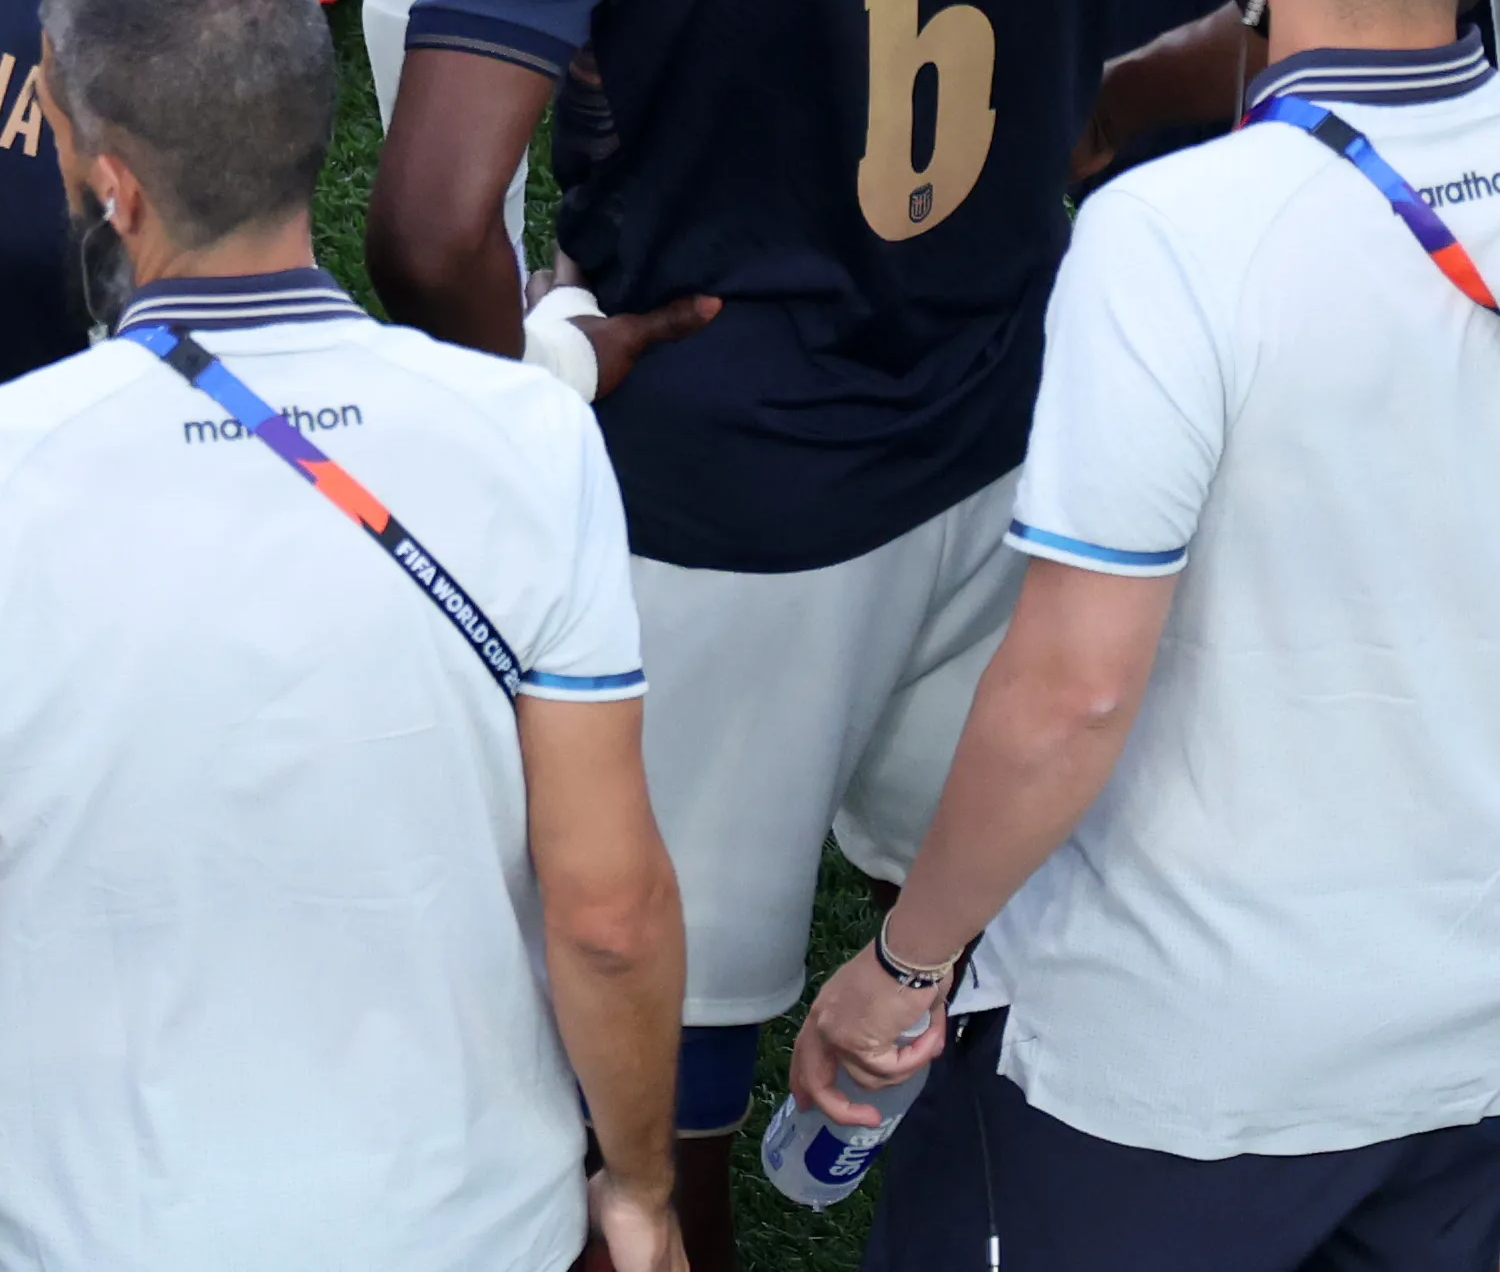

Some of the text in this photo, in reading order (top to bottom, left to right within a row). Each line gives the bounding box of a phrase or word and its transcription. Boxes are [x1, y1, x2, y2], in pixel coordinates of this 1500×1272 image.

[395, 538, 437, 586] FIFA
[432, 576, 489, 644] WORLD
[483, 637, 513, 672] CUP
